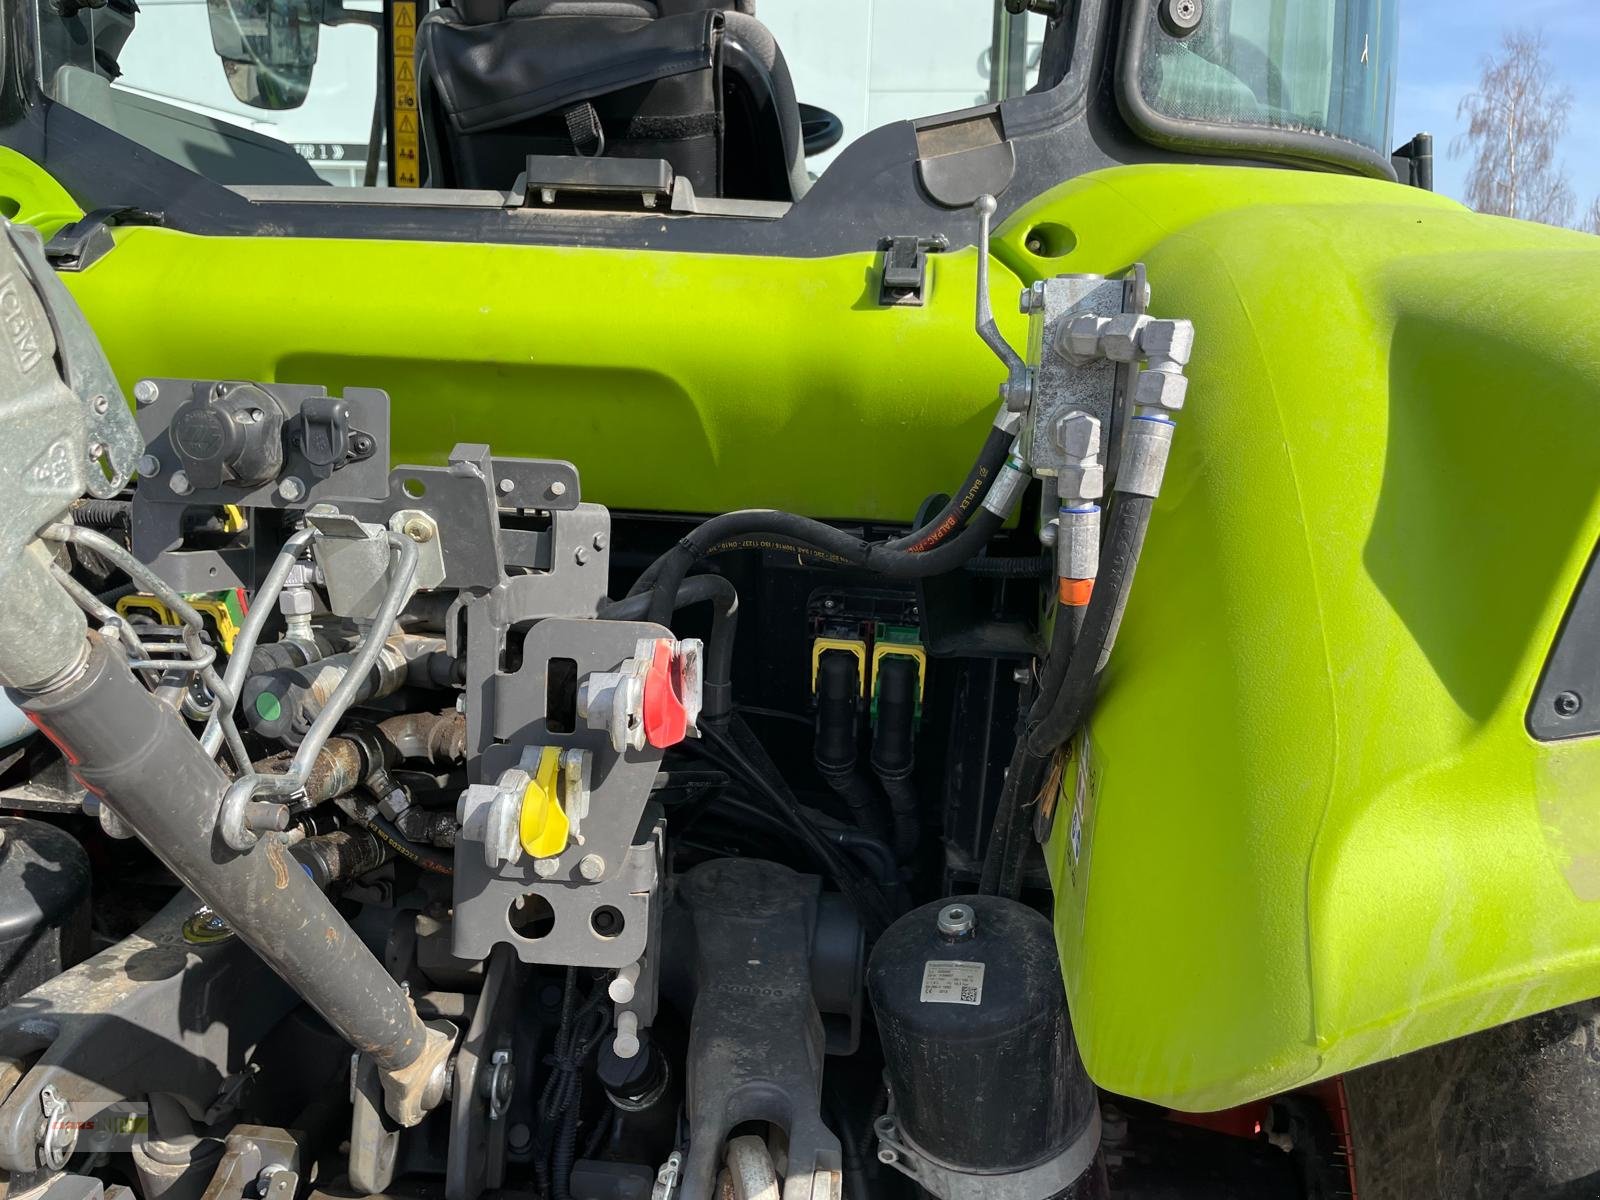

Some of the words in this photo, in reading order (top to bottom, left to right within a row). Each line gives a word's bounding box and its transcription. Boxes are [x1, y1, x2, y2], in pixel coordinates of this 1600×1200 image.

[960, 479, 983, 511] BALFLEX
[927, 516, 957, 545] BALPAC
[760, 540, 771, 548] ISO
[379, 829, 389, 841] DIN
[388, 839, 419, 861] EXCEEDS
